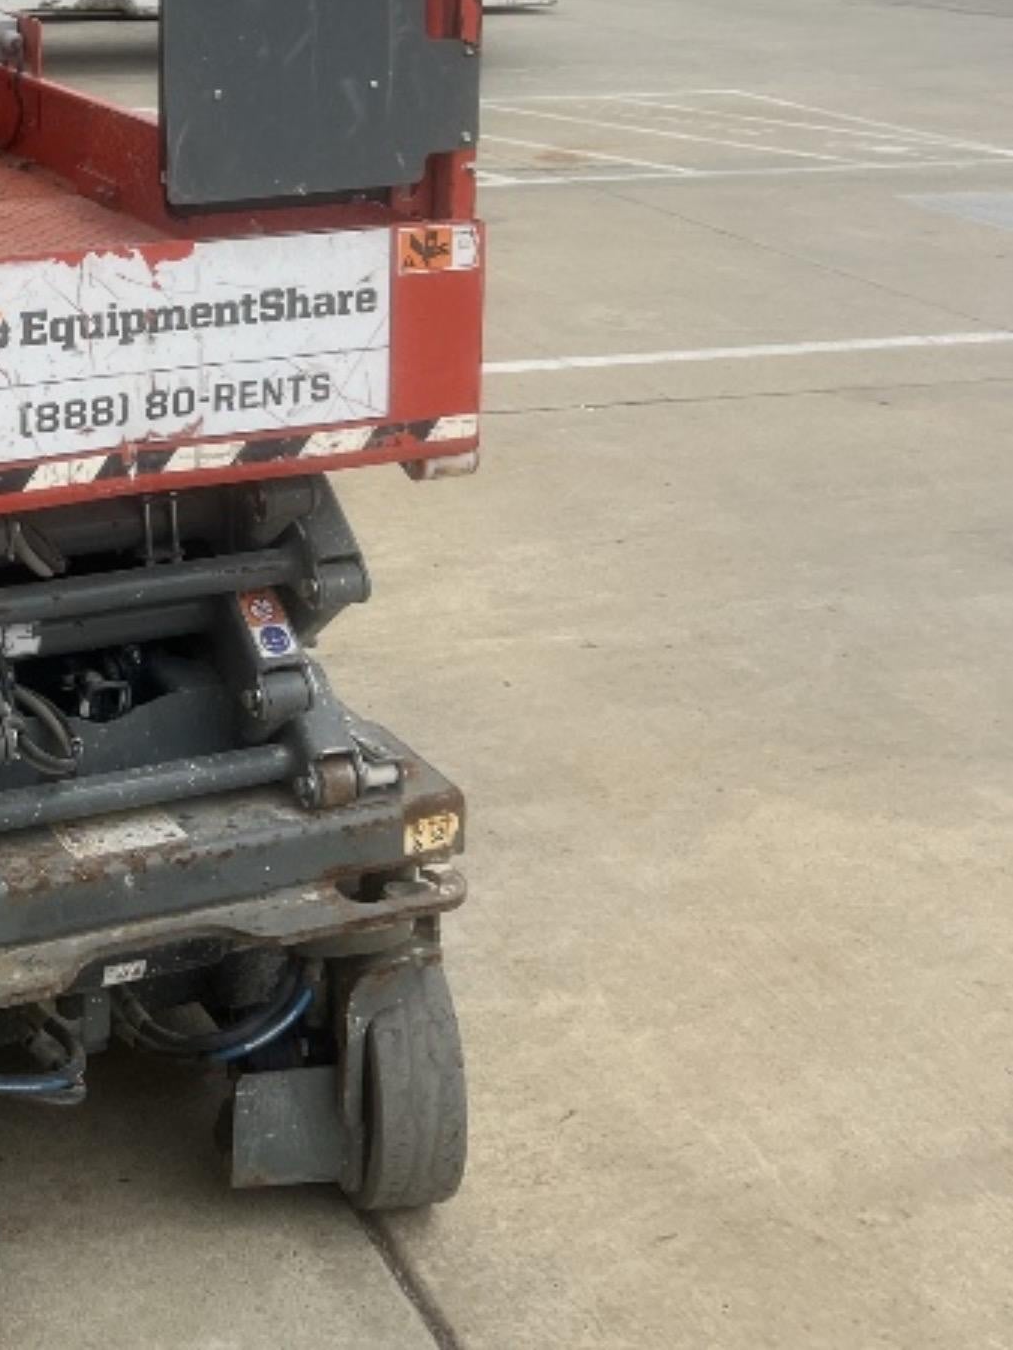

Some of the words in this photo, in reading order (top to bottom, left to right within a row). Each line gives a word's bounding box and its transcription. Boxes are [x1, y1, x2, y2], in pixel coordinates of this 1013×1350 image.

[19, 286, 378, 351] EquipmentShare
[19, 391, 129, 439] (888)
[145, 372, 331, 422] 80-RENTS
